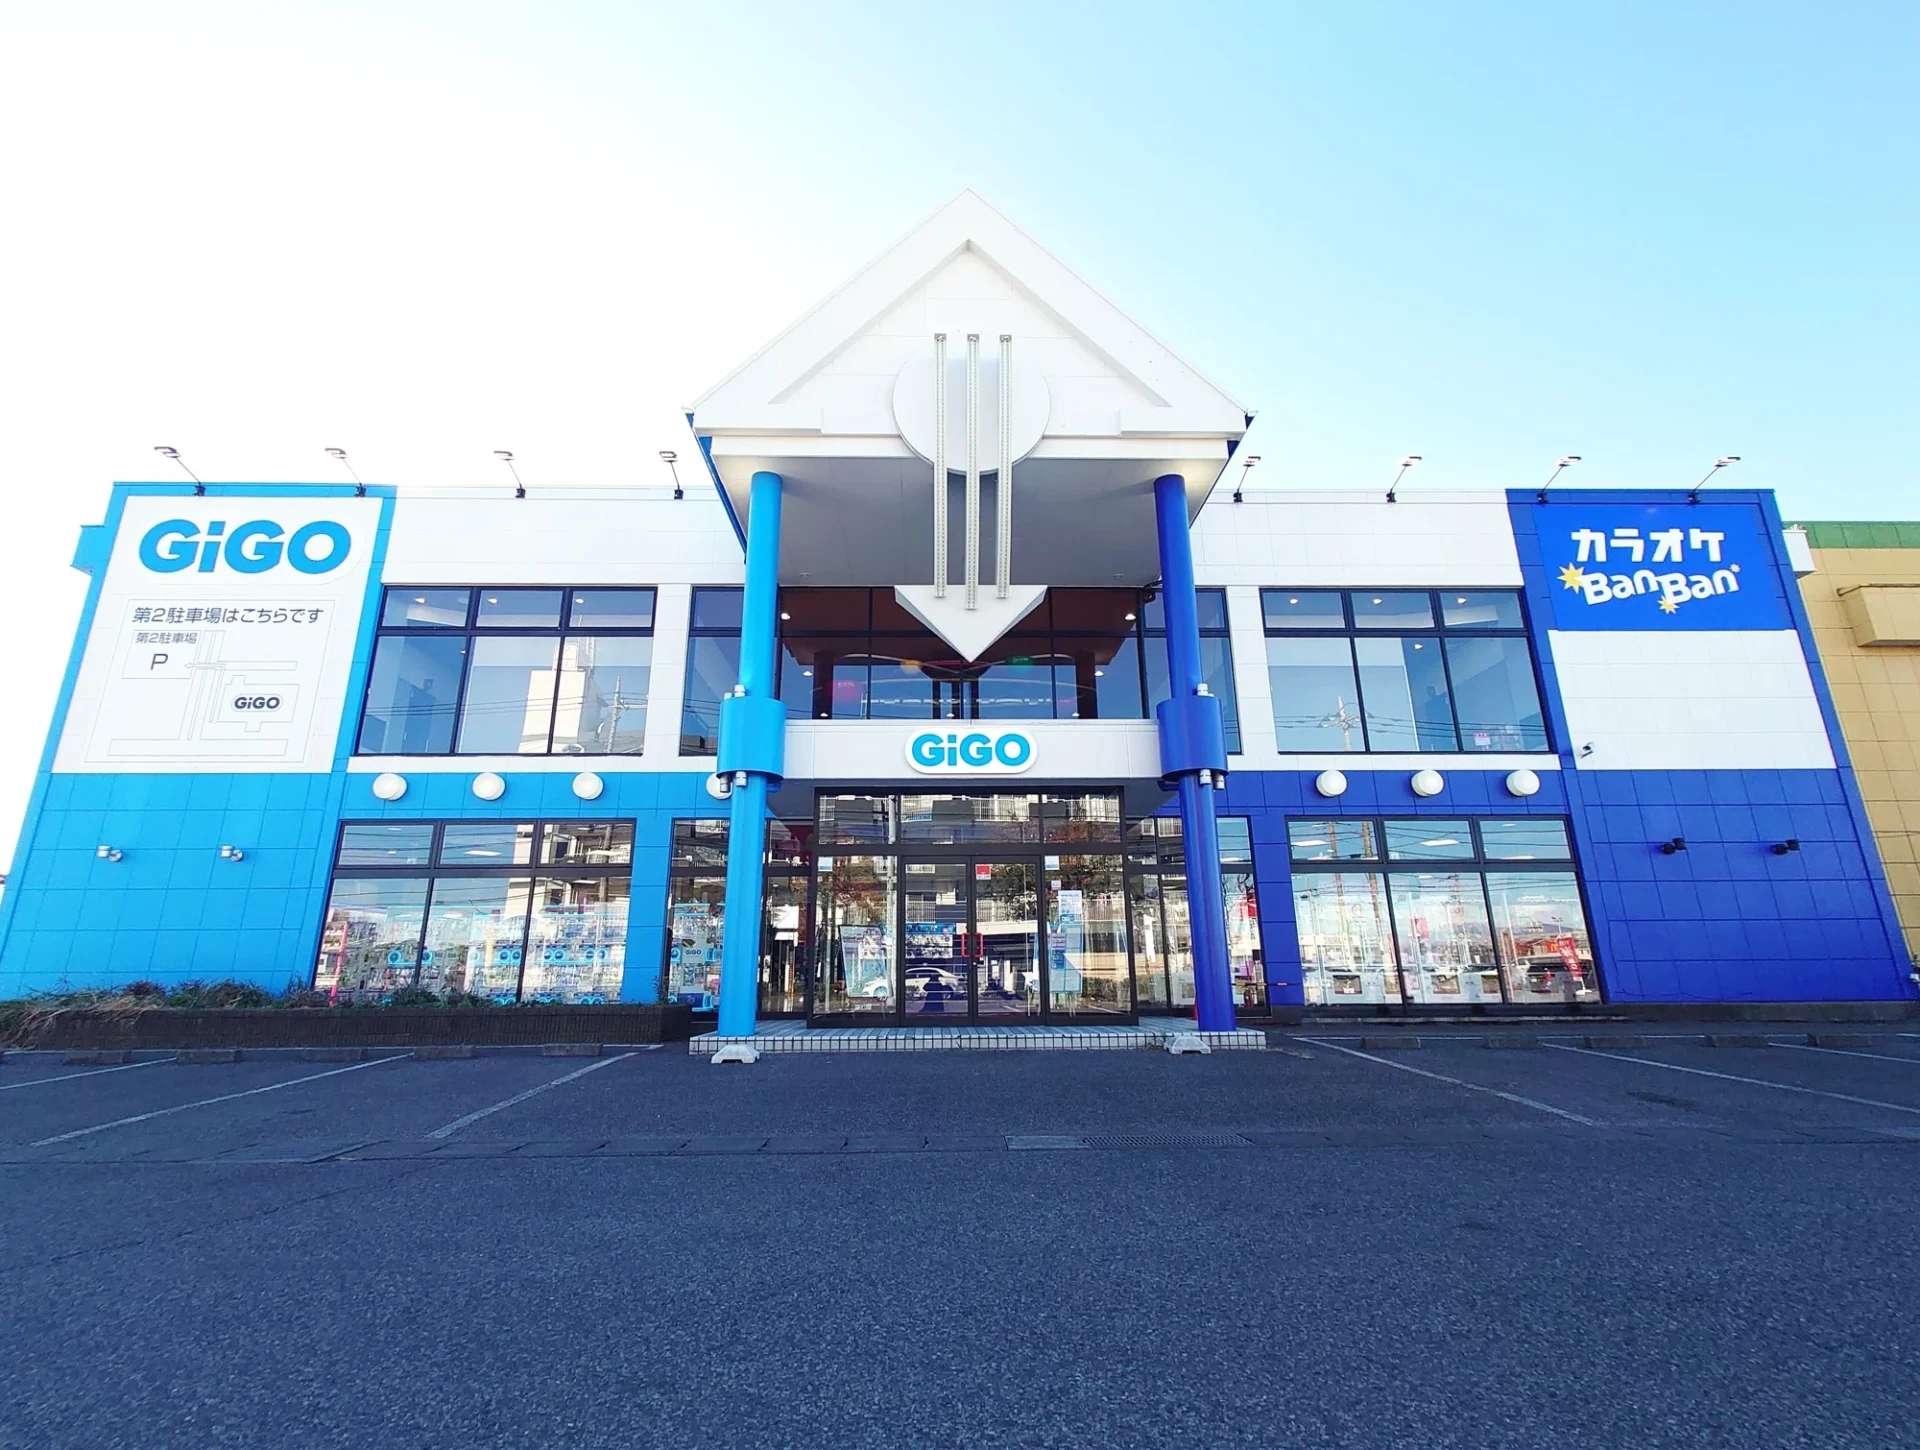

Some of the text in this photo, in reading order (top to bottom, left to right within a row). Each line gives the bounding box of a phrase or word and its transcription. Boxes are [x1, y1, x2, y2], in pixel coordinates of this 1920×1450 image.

[139, 519, 352, 574] GiGO
[1571, 528, 1725, 562] カラオケ
[1581, 569, 1740, 606] BanBan
[132, 607, 324, 624] 第2駐車場はこちらです
[135, 632, 198, 644] 第2駐車場
[150, 653, 169, 671] P
[234, 696, 281, 710] GiGO
[911, 733, 1031, 767] GiGO
